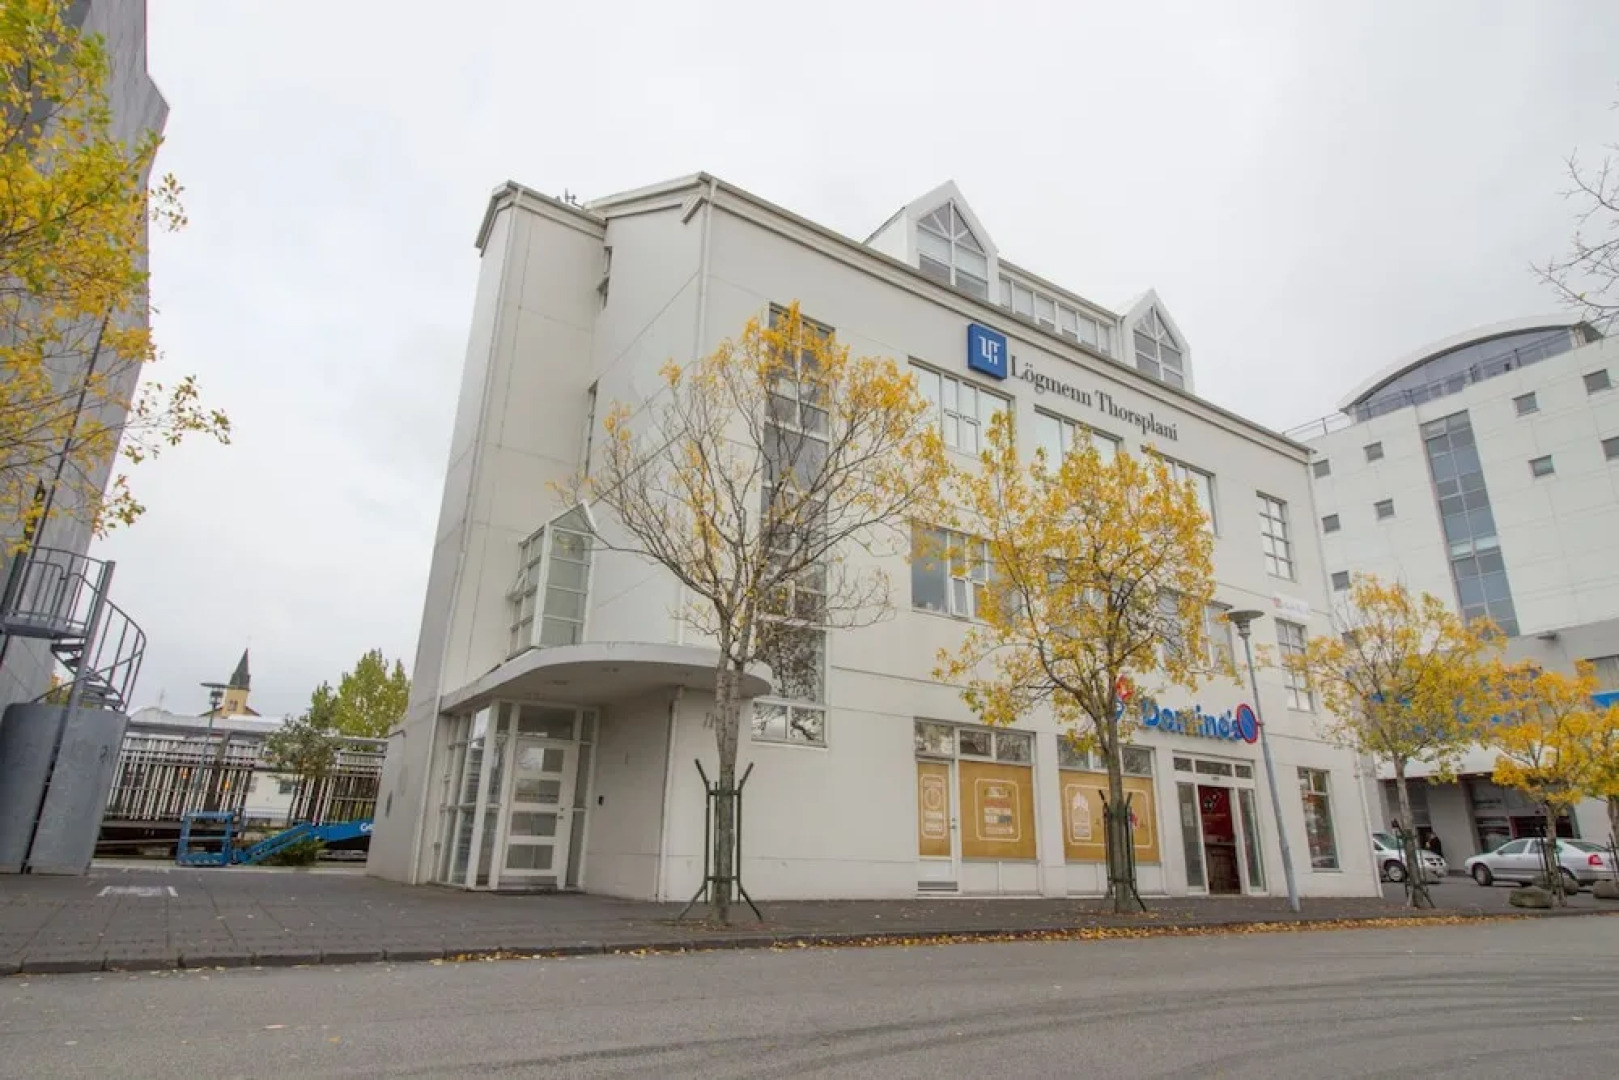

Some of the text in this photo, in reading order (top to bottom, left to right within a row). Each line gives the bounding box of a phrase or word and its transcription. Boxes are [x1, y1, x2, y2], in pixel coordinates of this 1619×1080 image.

[1011, 355, 1178, 441] Lögmenn Thorsplani
[1142, 699, 1243, 740] Doino's
